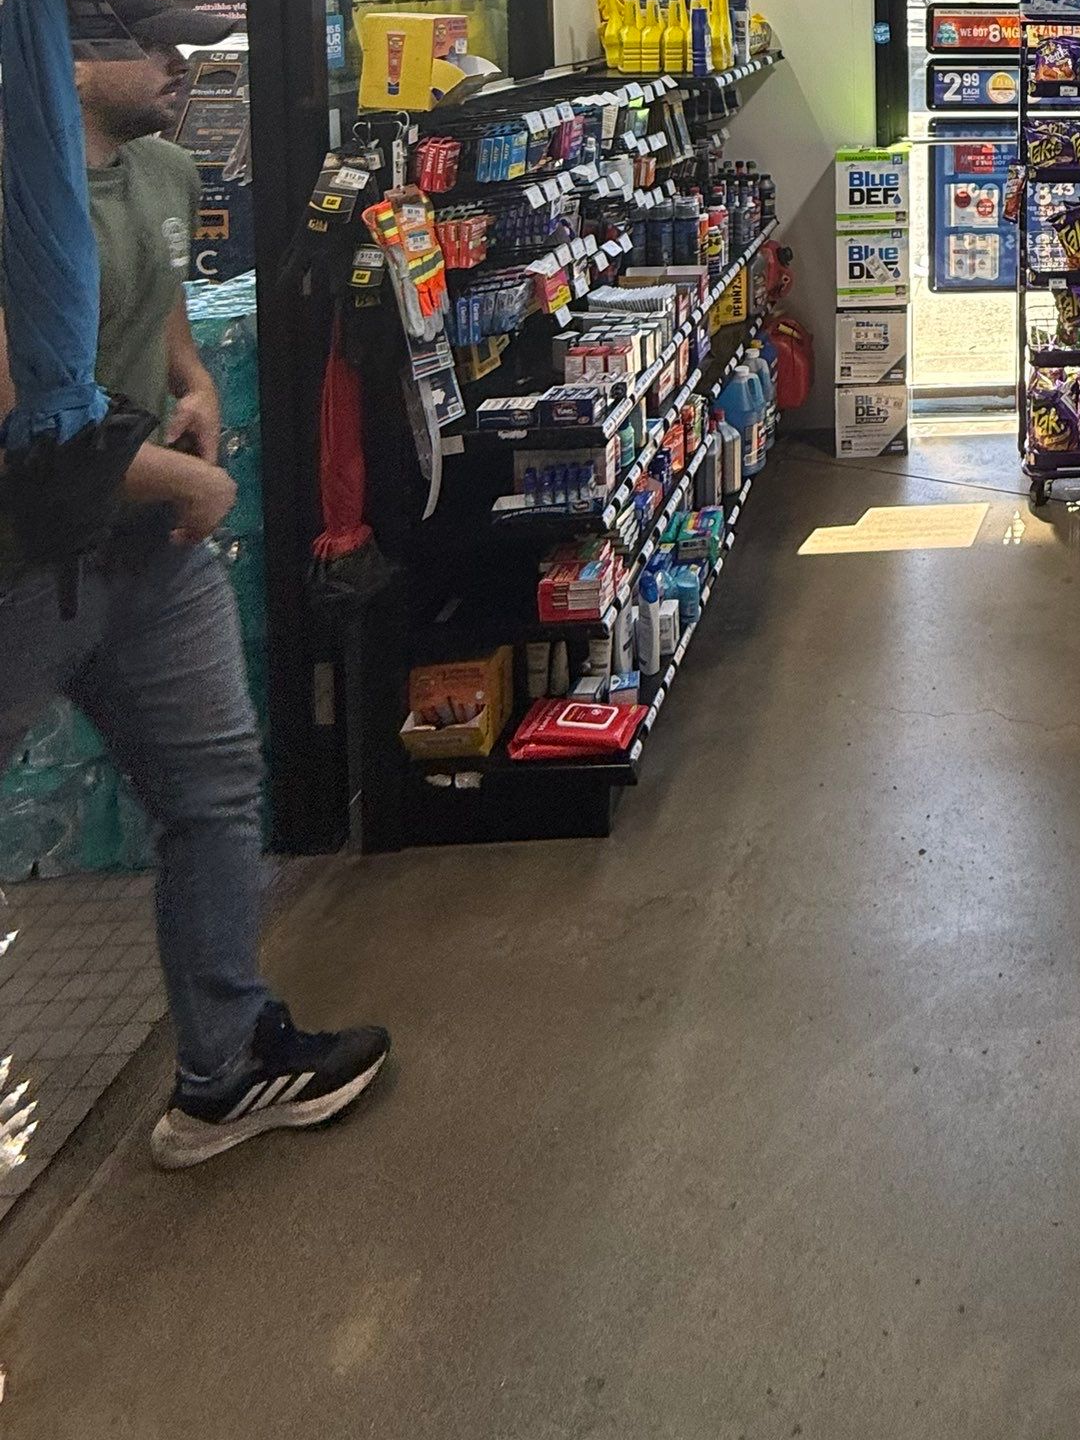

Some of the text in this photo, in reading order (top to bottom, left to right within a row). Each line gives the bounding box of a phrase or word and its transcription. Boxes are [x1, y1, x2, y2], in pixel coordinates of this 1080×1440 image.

[960, 28, 972, 37] WE
[973, 27, 988, 37] GOT
[1028, 140, 1062, 165] Takis
[849, 171, 899, 187] Blue
[325, 197, 340, 208] CAT
[849, 188, 898, 206] DEF
[849, 262, 898, 279] DF
[1032, 407, 1064, 434] Tak
